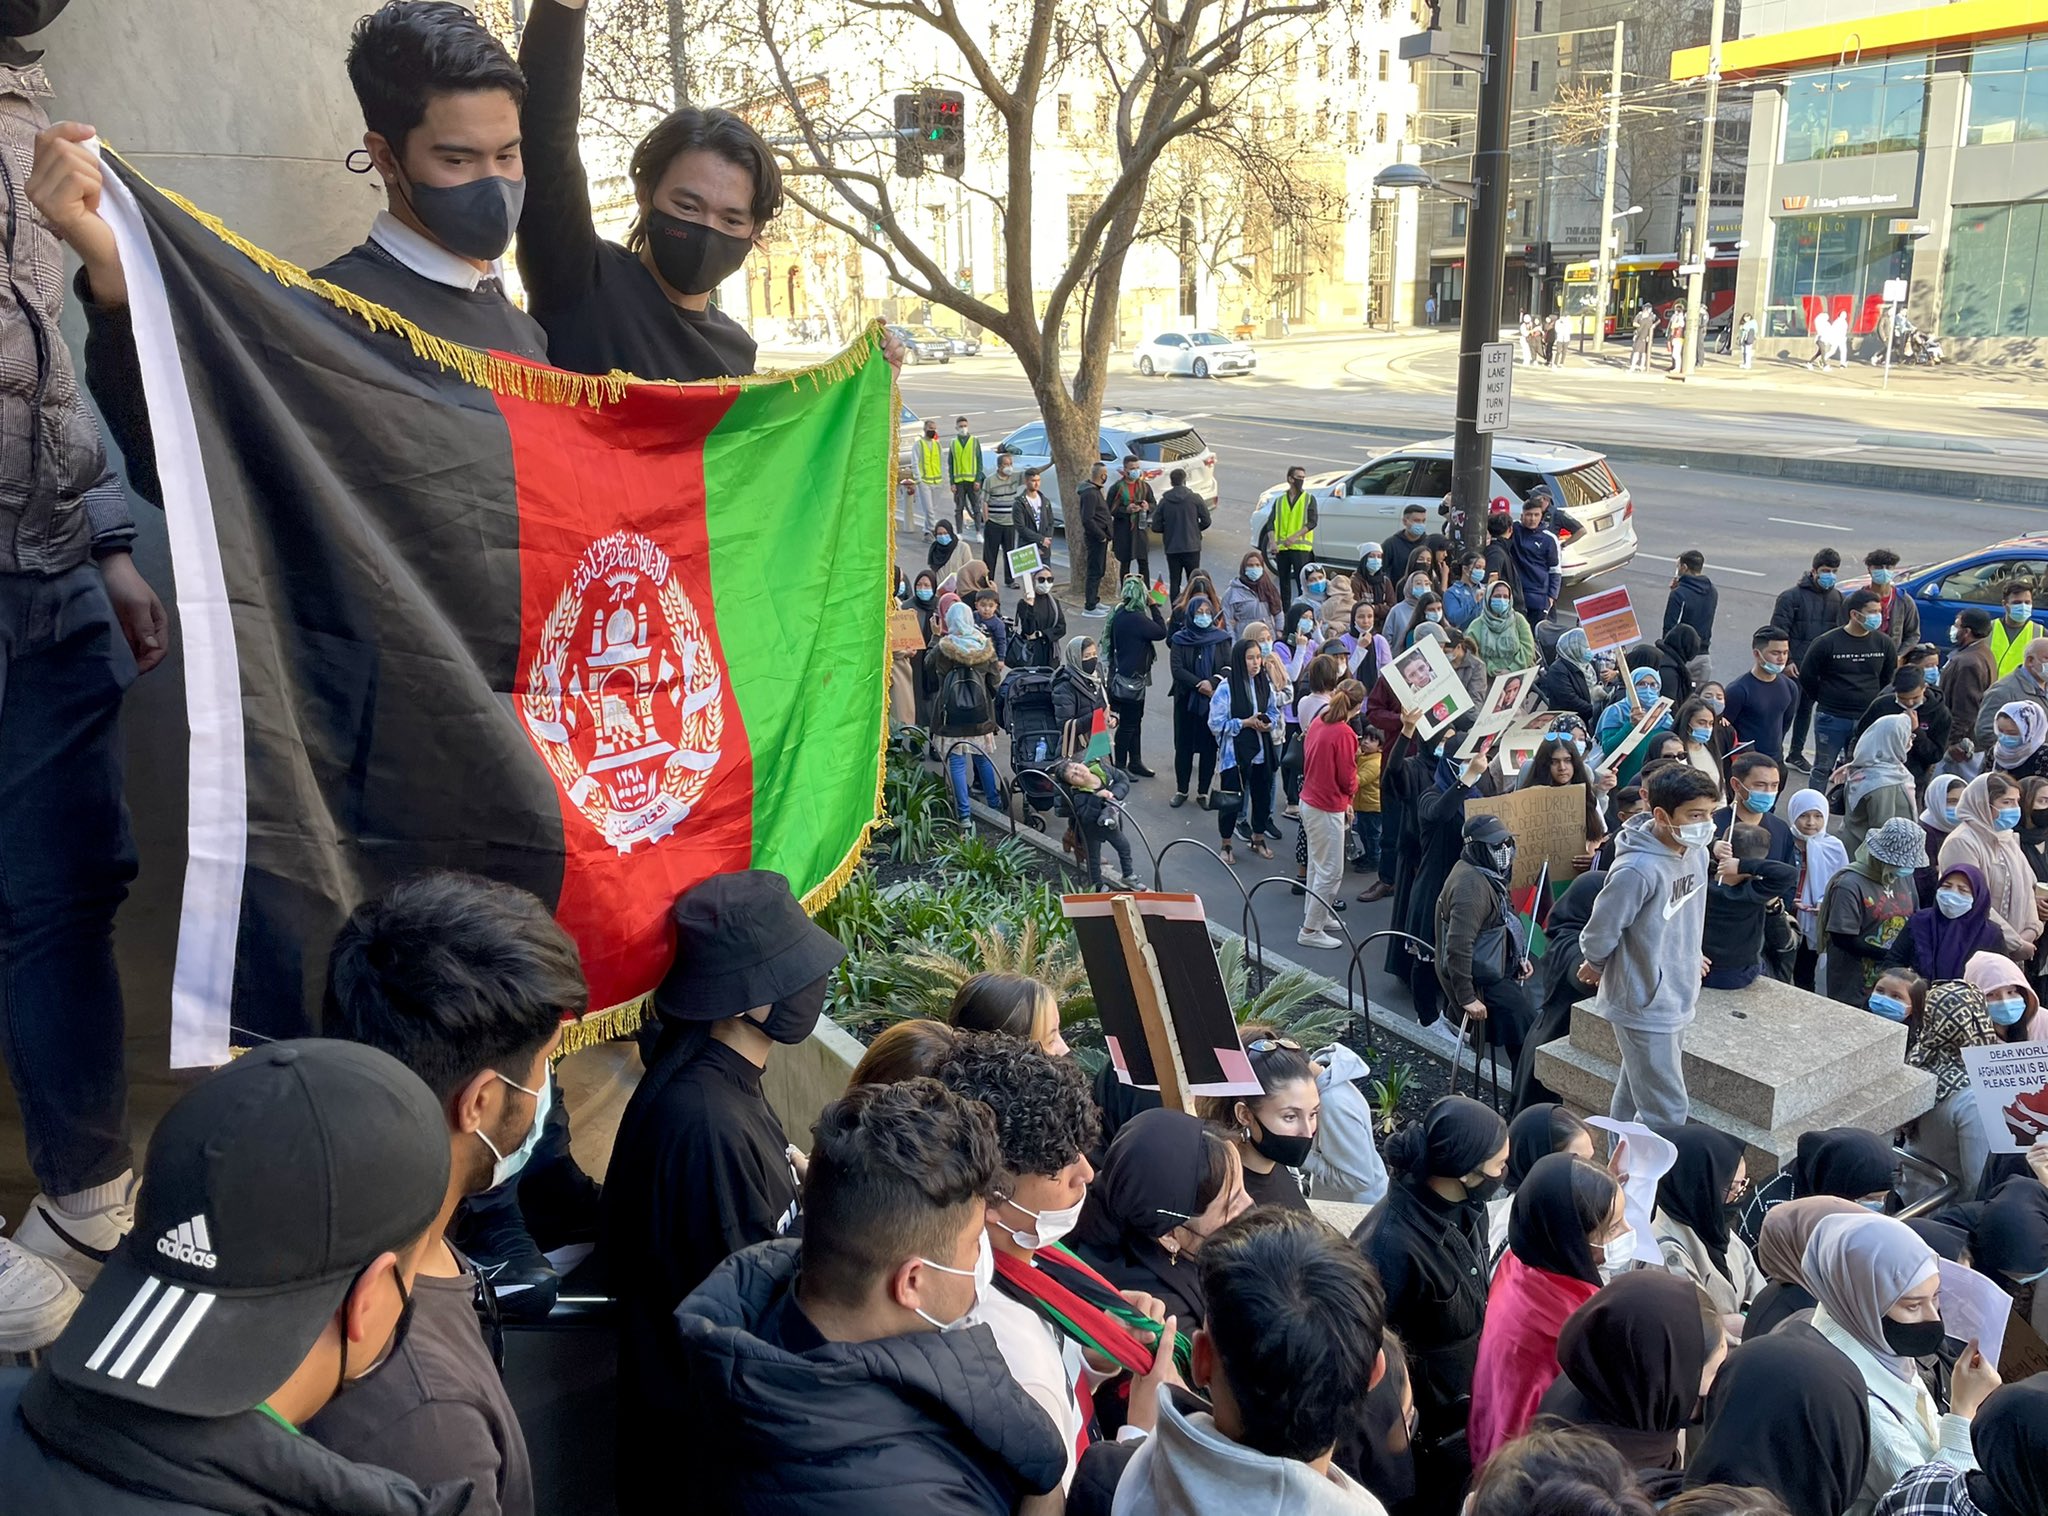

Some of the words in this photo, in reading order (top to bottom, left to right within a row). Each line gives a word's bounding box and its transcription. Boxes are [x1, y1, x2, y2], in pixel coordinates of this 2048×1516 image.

[1488, 352, 1507, 364] LEFT
[1487, 368, 1505, 378] LANE
[1487, 383, 1504, 393] MUST
[1486, 398, 1503, 408] TURN
[1483, 412, 1503, 424] LEFT
[1521, 795, 1575, 814] CHILDREN
[1519, 815, 1543, 830] DEAD
[1563, 811, 1577, 823] THE
[1670, 873, 1695, 903] NIKE
[1989, 1048, 2014, 1060] DEAR
[2015, 1046, 2048, 1057] WORL
[1978, 1062, 2026, 1077] AFGHANISTAN
[2028, 1062, 2036, 1073] IS
[1983, 1077, 2017, 1088] PLEASE
[2019, 1075, 2046, 1086] SAVE
[156, 1235, 217, 1268] adidas
